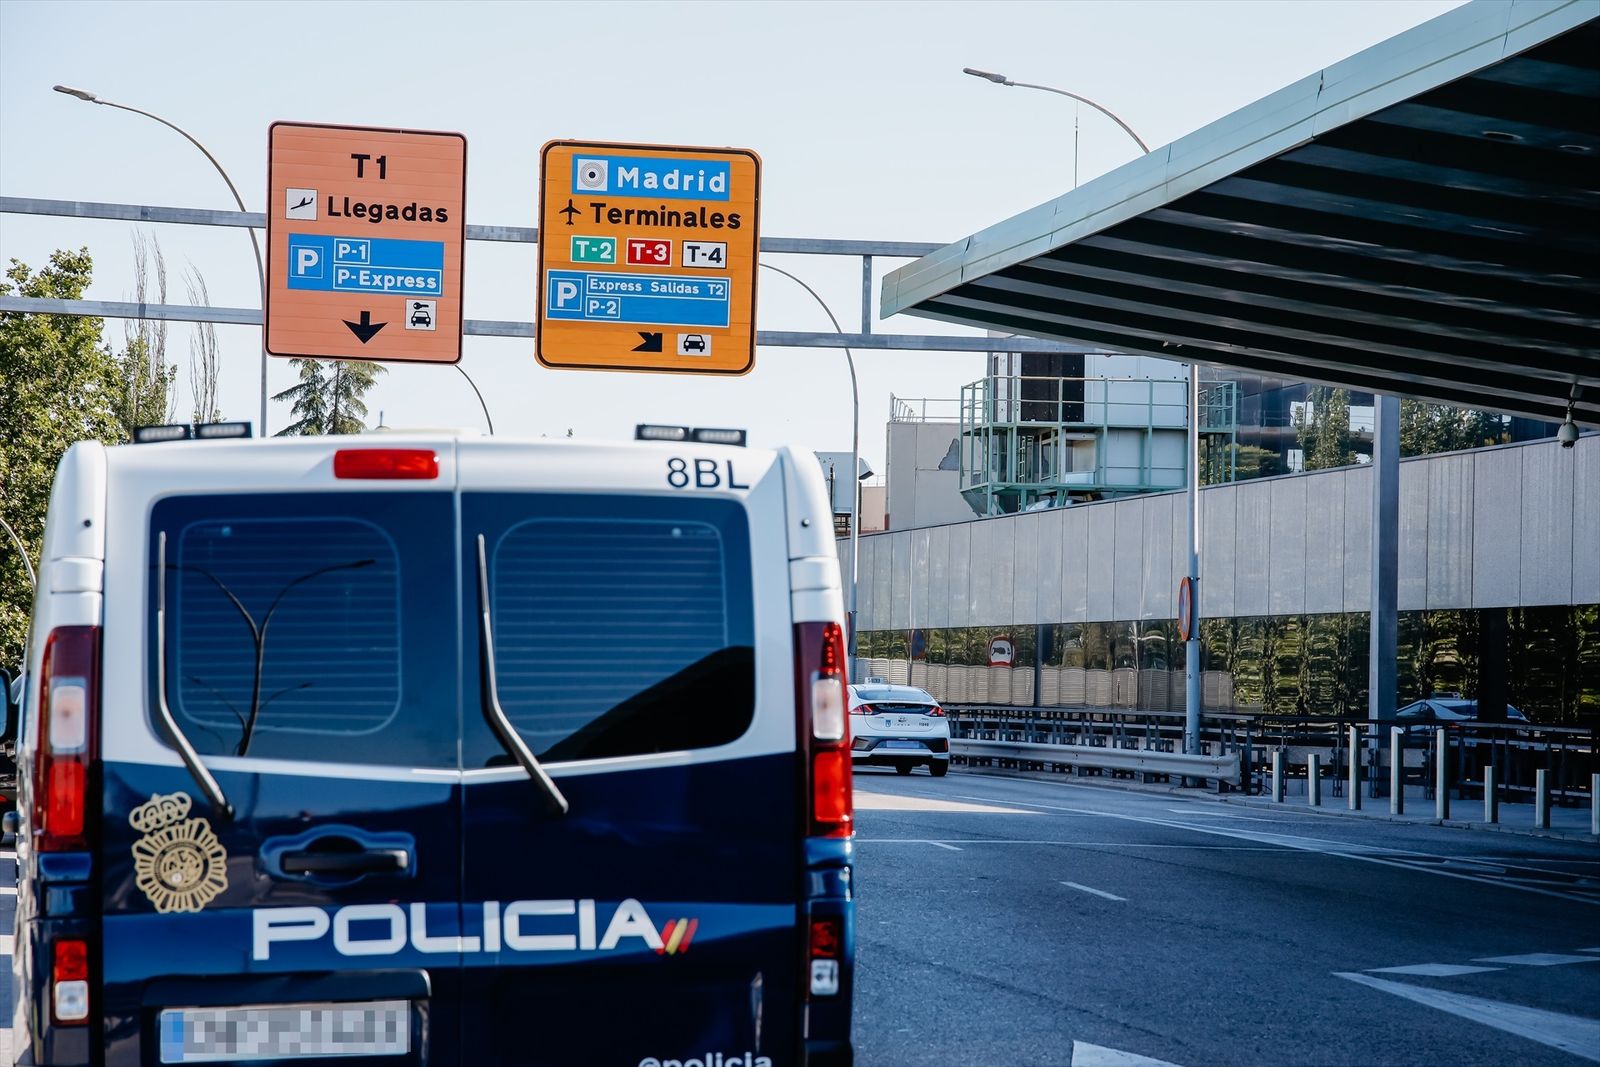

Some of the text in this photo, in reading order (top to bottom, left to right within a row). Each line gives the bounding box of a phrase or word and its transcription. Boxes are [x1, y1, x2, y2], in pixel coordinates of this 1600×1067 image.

[351, 153, 387, 180] T1
[617, 166, 726, 193] Madrid
[327, 196, 449, 223] Llegadas
[590, 202, 741, 229] Terminales
[297, 248, 319, 275] P
[338, 243, 367, 260] P-1
[576, 241, 612, 259] T-2
[632, 243, 667, 261] T-3
[687, 245, 722, 263] T-4
[337, 269, 437, 291] P-Express
[589, 278, 724, 295] Express Salidas T2
[557, 281, 578, 308] P
[589, 300, 617, 315] P-2
[667, 457, 750, 489] 8BL
[253, 898, 664, 961] POLICIA
[638, 1052, 772, 1067] licia
